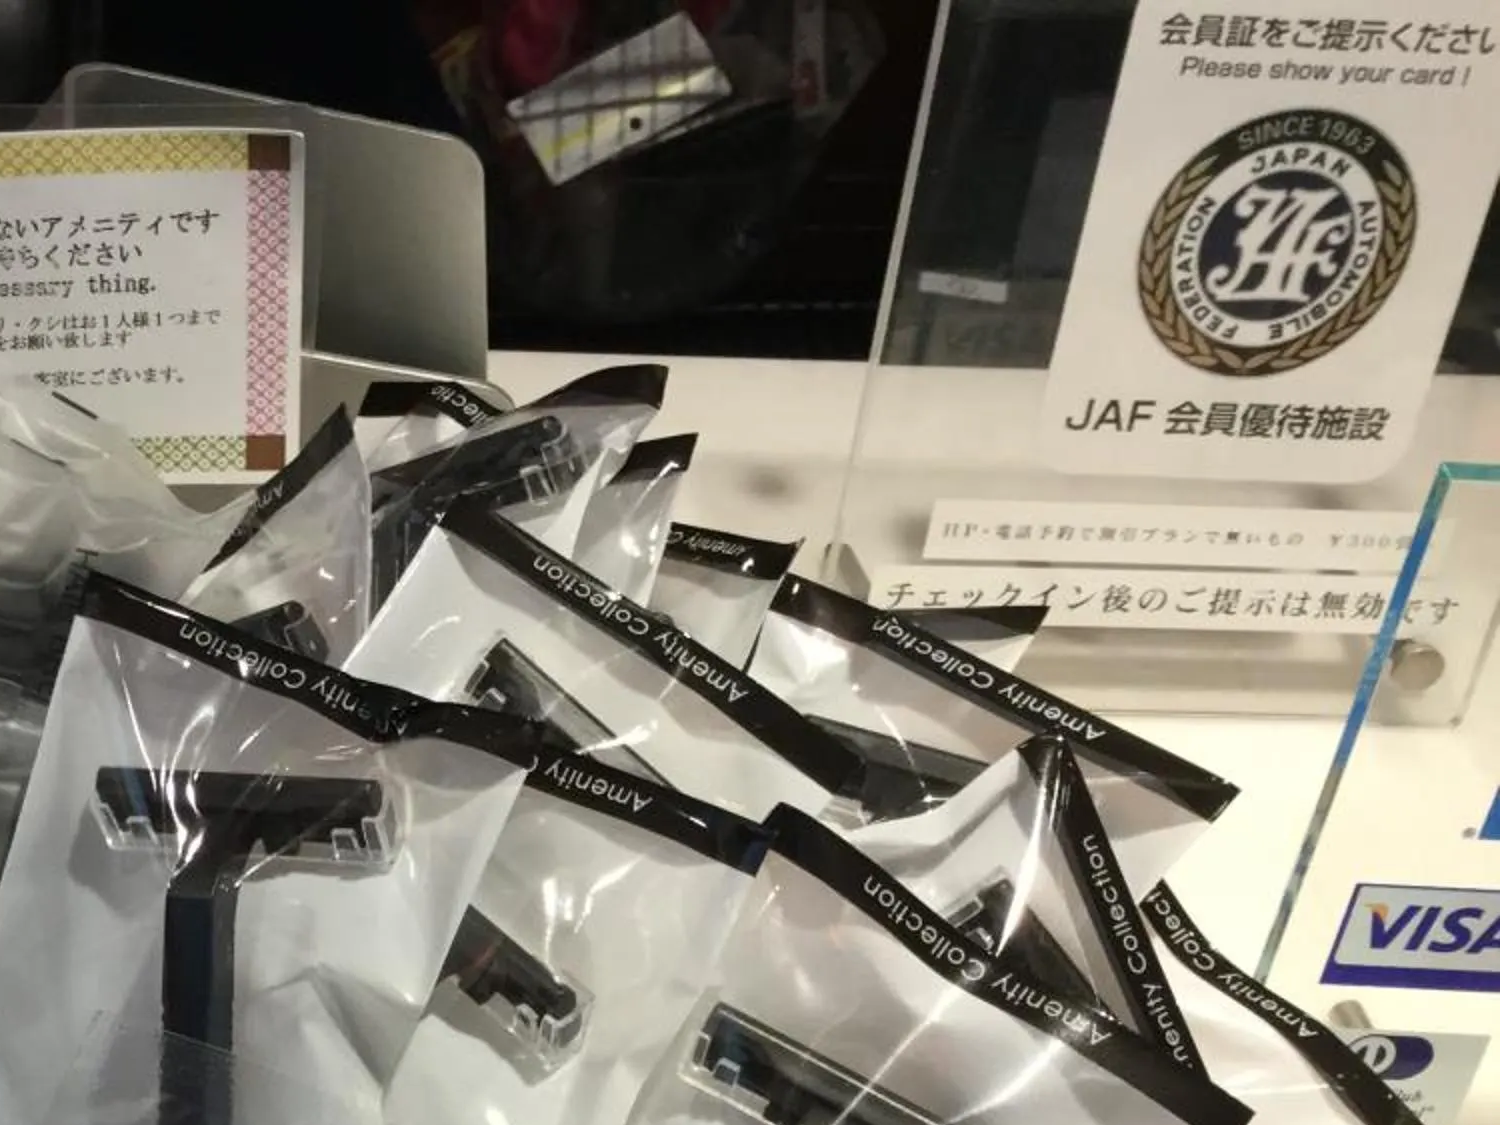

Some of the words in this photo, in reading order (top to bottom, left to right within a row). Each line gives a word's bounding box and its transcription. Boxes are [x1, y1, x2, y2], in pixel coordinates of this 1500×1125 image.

[1179, 56, 1262, 80] Please
[1269, 58, 1333, 81] show
[1338, 64, 1394, 84] your
[1400, 65, 1455, 85] card
[1238, 114, 1315, 150] SINCE
[1319, 117, 1377, 154] 1963
[1250, 147, 1353, 177] JAPAN
[87, 271, 158, 296] thing.
[1176, 196, 1240, 340] FEDERATION
[1268, 200, 1379, 340] AUTOMOBILE
[1065, 399, 1157, 432] JAF
[1163, 400, 1392, 442] 会員優待施設
[533, 552, 651, 636] Collection
[179, 620, 307, 690] Collection
[654, 626, 748, 703] Amenity
[871, 616, 994, 690] Collection
[997, 684, 1107, 741] Amenity
[544, 757, 654, 813] Amenity
[863, 874, 987, 982] Collection
[1082, 833, 1148, 975] Collection
[1364, 902, 1500, 955] VISA
[991, 970, 1114, 1046] Amenity
[1217, 973, 1318, 1037] Amenity
